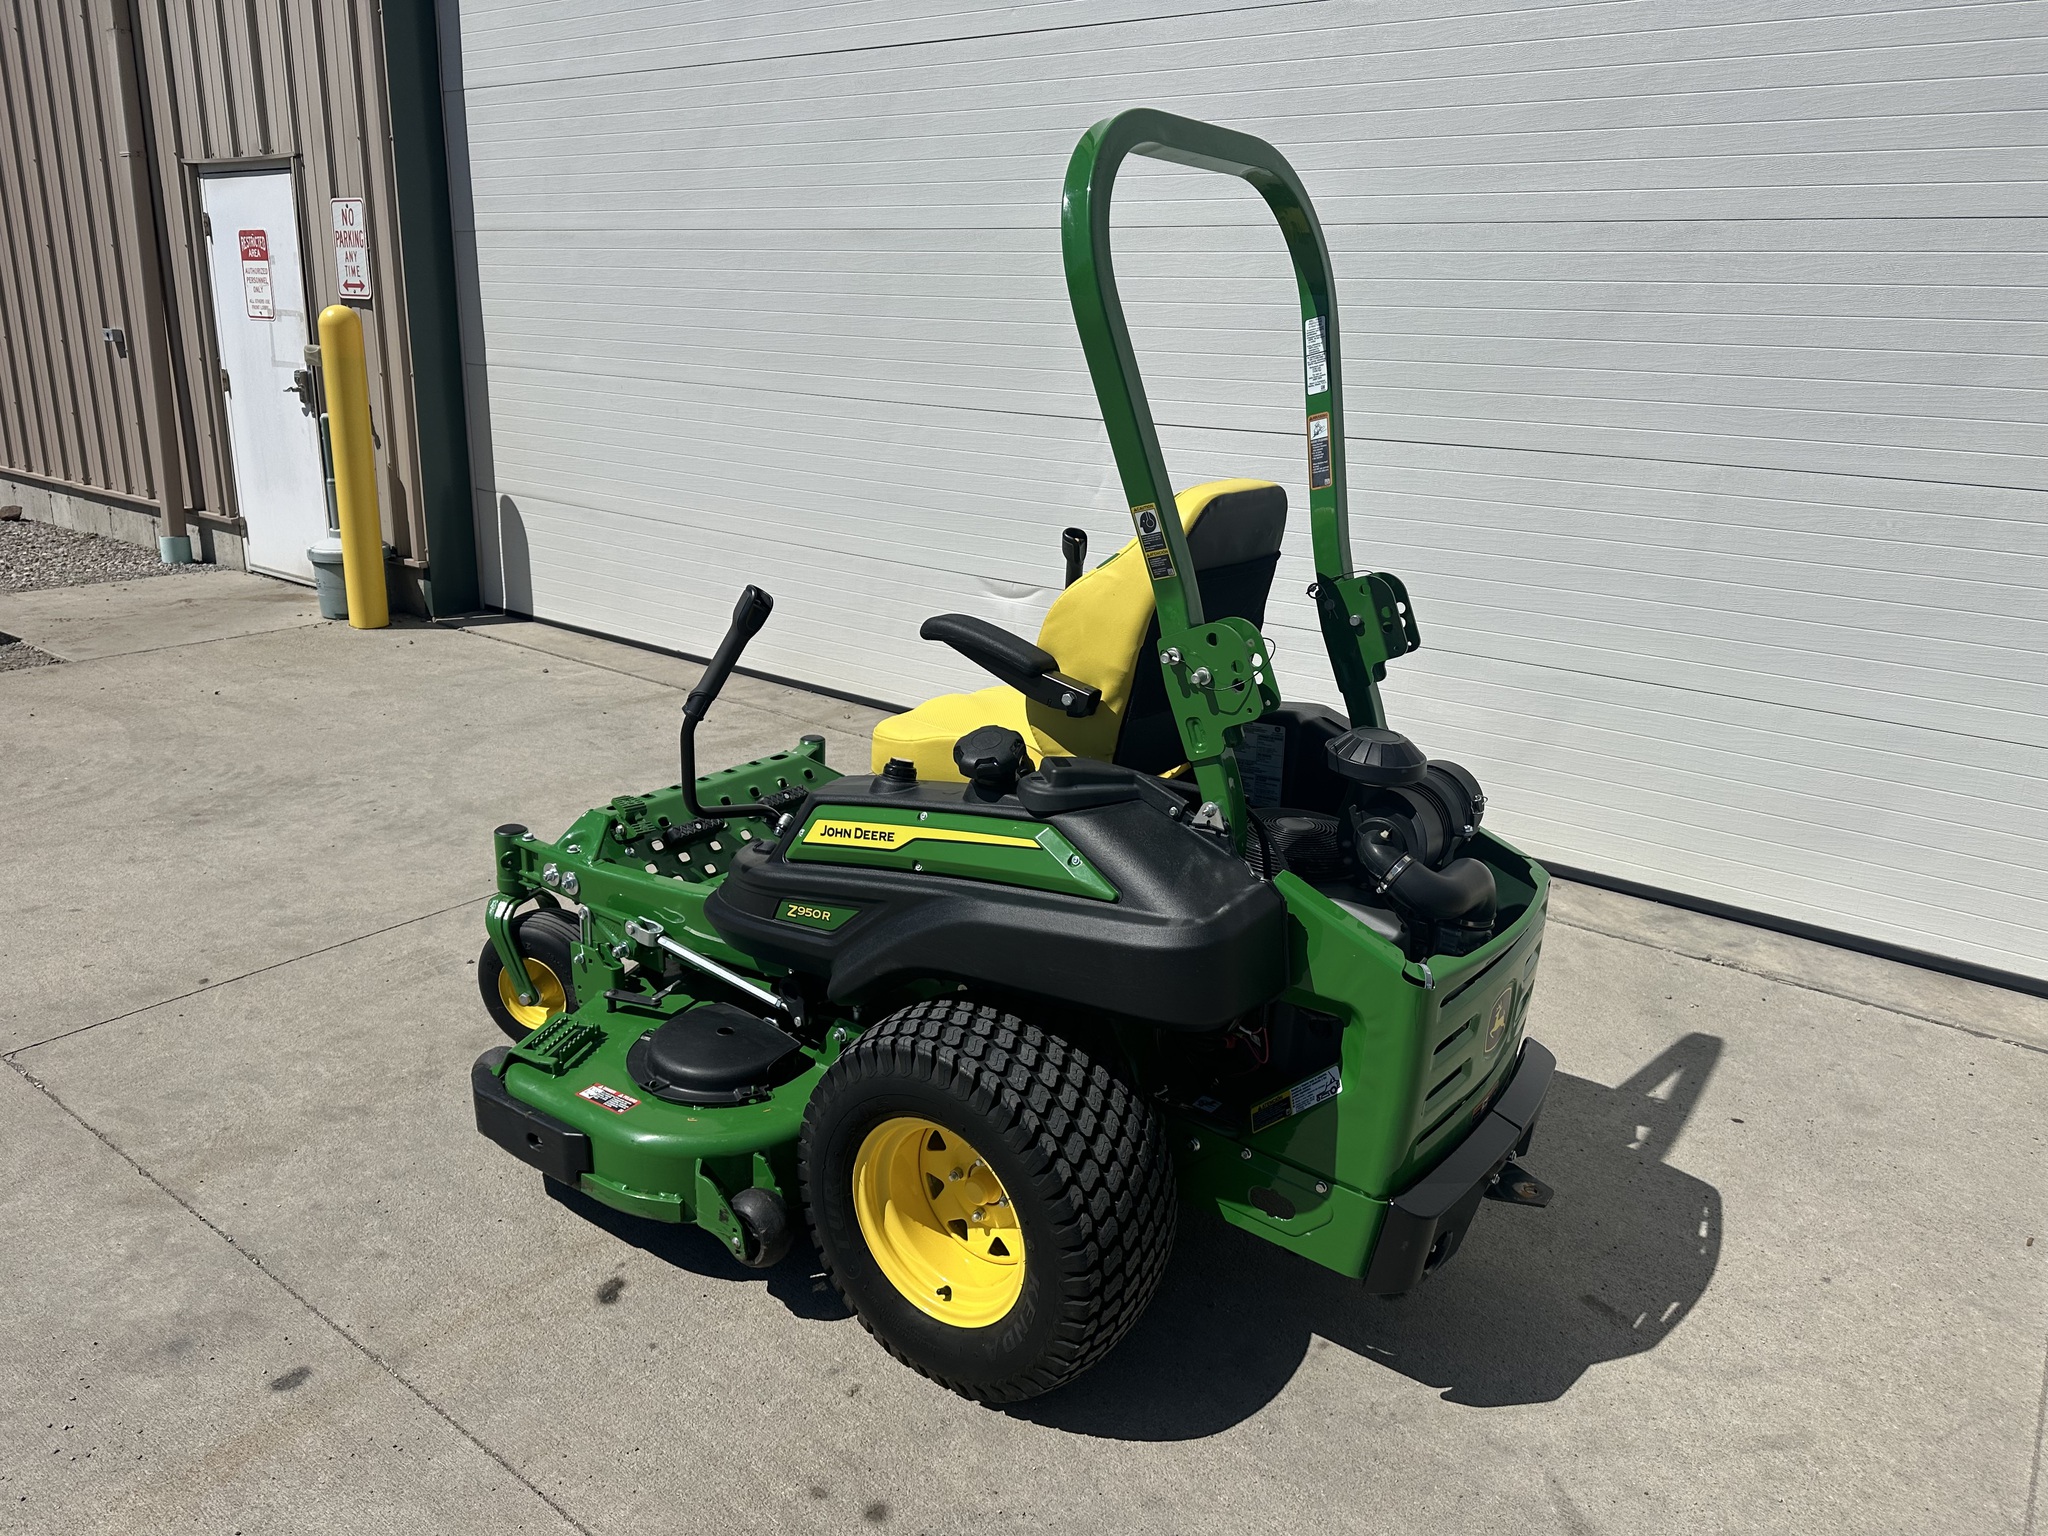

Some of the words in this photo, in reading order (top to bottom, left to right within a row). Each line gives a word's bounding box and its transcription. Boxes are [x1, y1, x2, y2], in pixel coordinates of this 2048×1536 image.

[341, 208, 354, 226] NO
[240, 235, 266, 251] RESTRICTED
[335, 230, 364, 248] PARKING
[248, 249, 261, 257] AREA
[344, 250, 358, 263] ANY
[245, 267, 268, 275] AUTHORIZED
[344, 265, 361, 278] TIME
[246, 276, 269, 285] PERSONNEL
[252, 285, 264, 293] ONLY
[820, 825, 852, 839] JOHN
[854, 827, 895, 842] DEERE
[787, 904, 831, 921] Z950R
[985, 1268, 1041, 1362] KENDA
